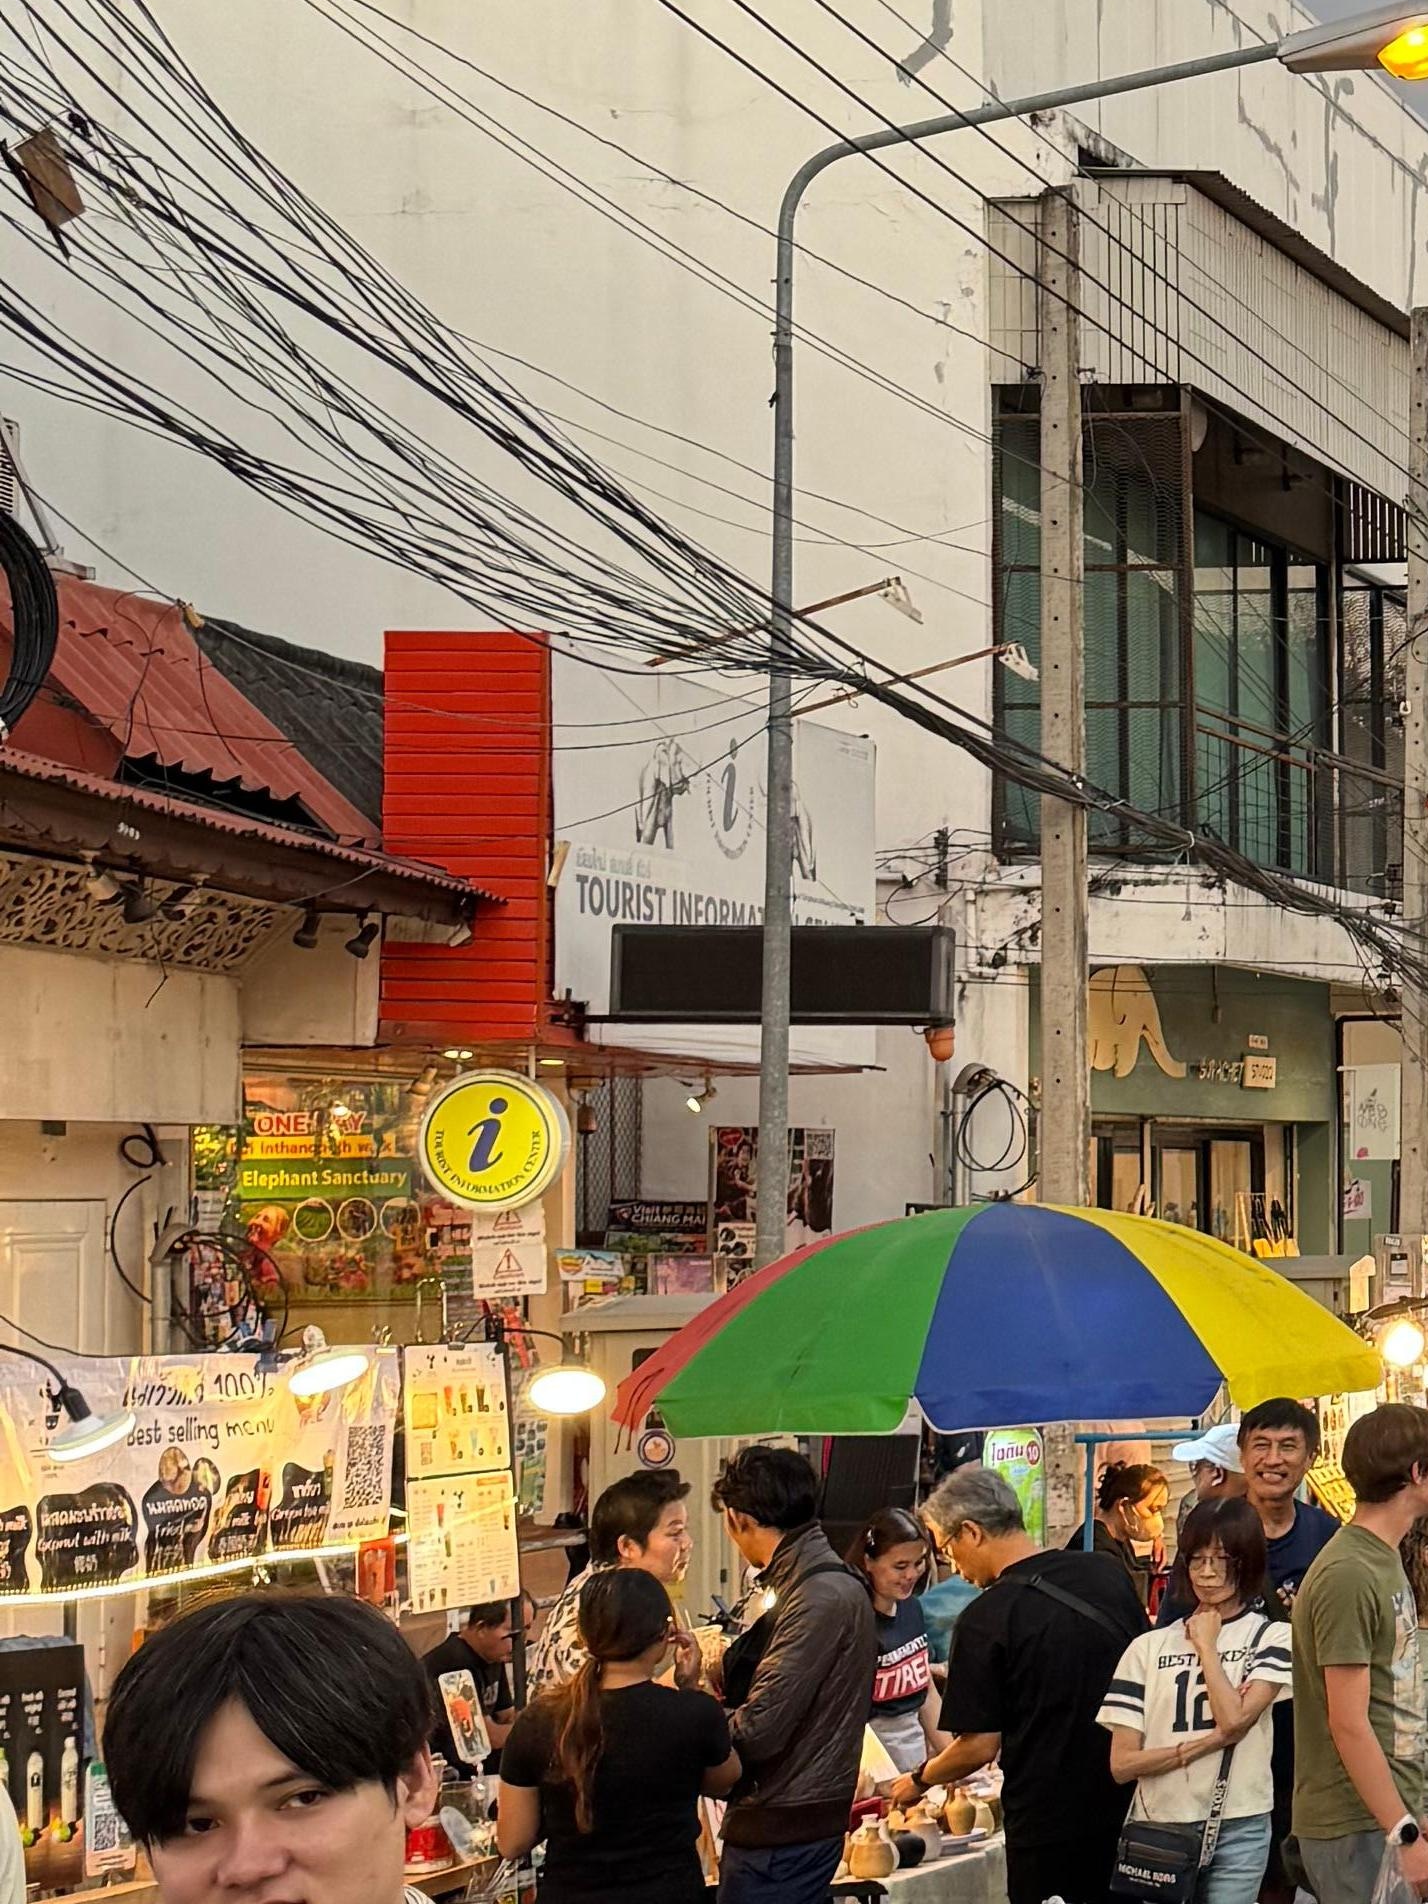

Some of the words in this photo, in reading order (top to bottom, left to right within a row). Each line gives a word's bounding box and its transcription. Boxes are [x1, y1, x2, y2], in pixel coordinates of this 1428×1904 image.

[576, 874, 666, 924] TOURIST
[256, 1113, 307, 1135] ONE
[434, 1128, 449, 1174] TOURIST
[450, 1173, 526, 1194] INFORMATION
[522, 1129, 541, 1173] CENTER
[242, 1169, 318, 1189] Elephant
[321, 1169, 408, 1189] Sanctuary
[631, 1214, 680, 1225] CHIANG
[168, 1416, 221, 1450] selling
[226, 1418, 275, 1438] menu
[1158, 1653, 1196, 1669] BEST
[1172, 1670, 1218, 1733] 12
